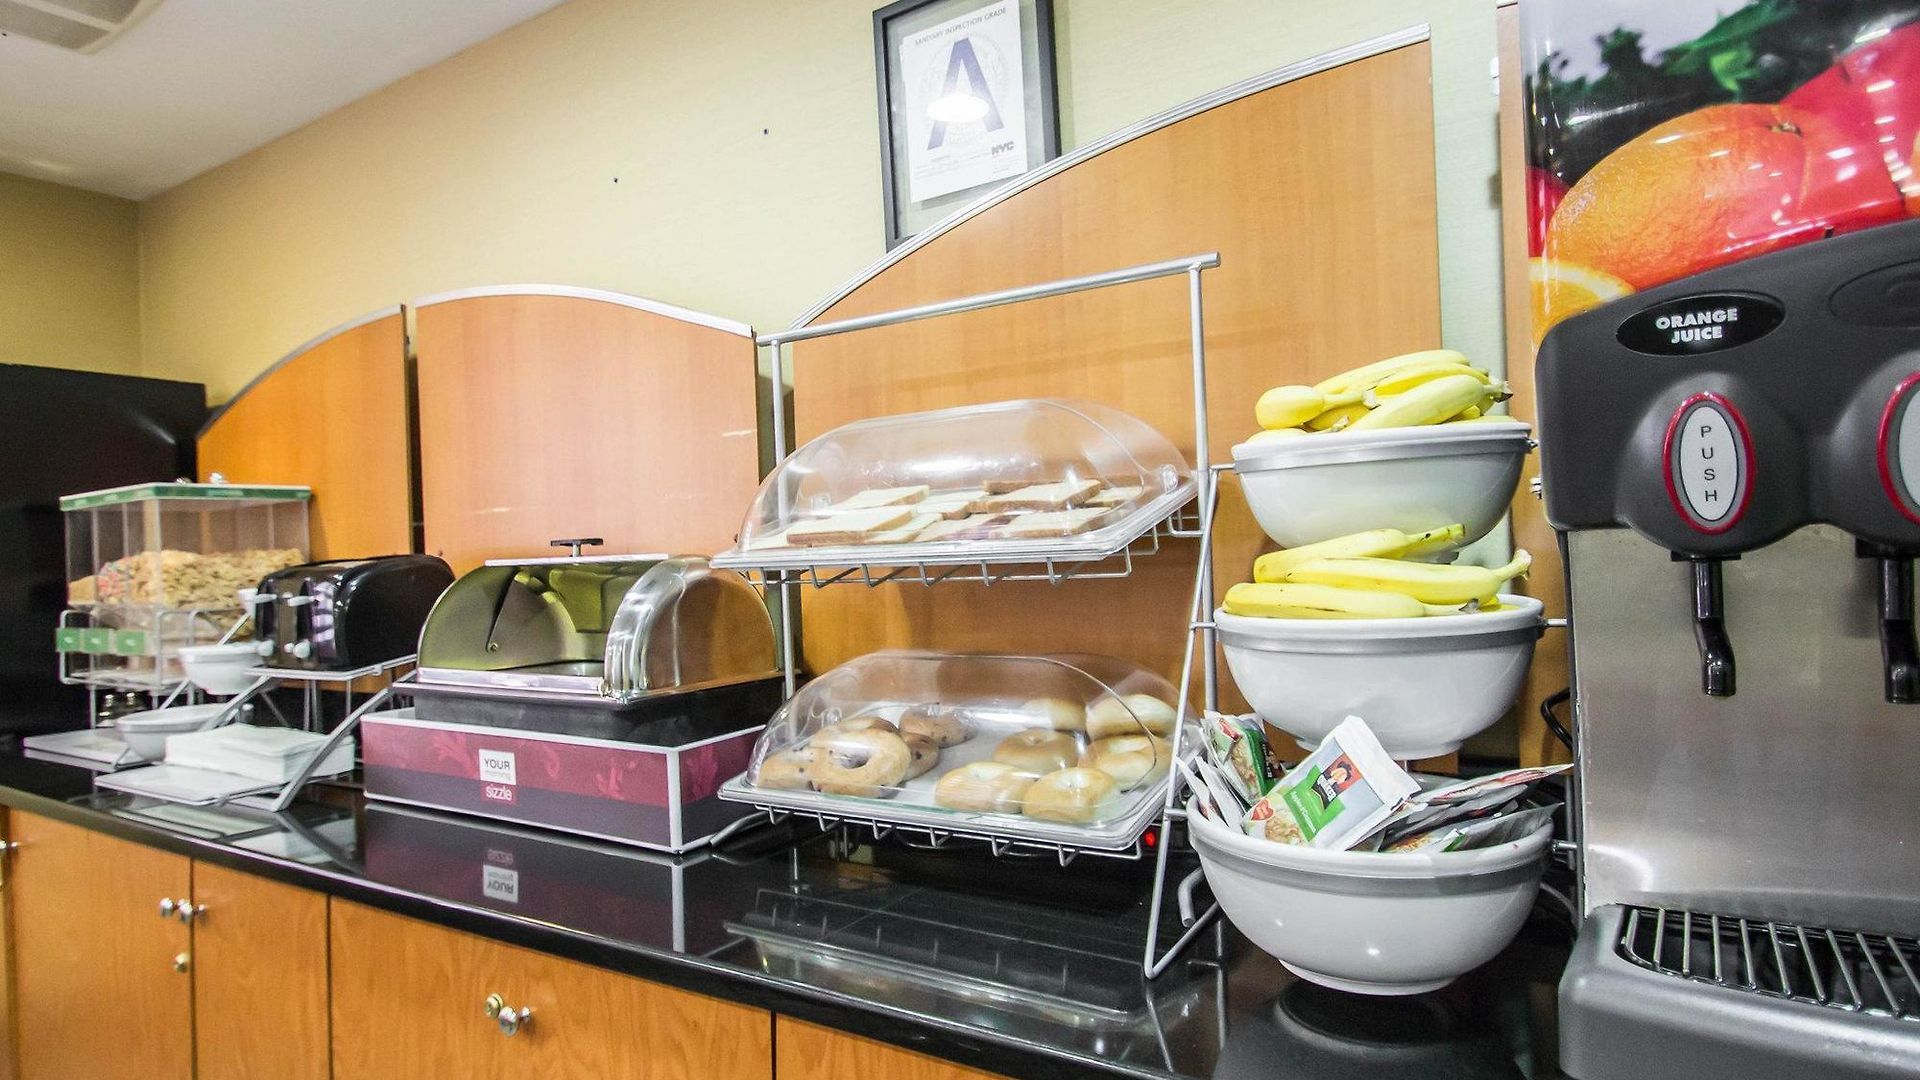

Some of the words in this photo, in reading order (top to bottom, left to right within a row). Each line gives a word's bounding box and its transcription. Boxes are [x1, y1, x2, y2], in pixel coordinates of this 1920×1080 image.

[944, 16, 983, 34] INSPECTION
[984, 7, 1007, 21] GRADE
[927, 37, 1005, 150] A
[991, 141, 1015, 156] NYC
[1655, 307, 1738, 330] ORANGE
[1671, 325, 1723, 344] JUICE
[1700, 425, 1718, 502] PUSH
[484, 758, 511, 770] YOUR
[485, 783, 513, 802] sizzle
